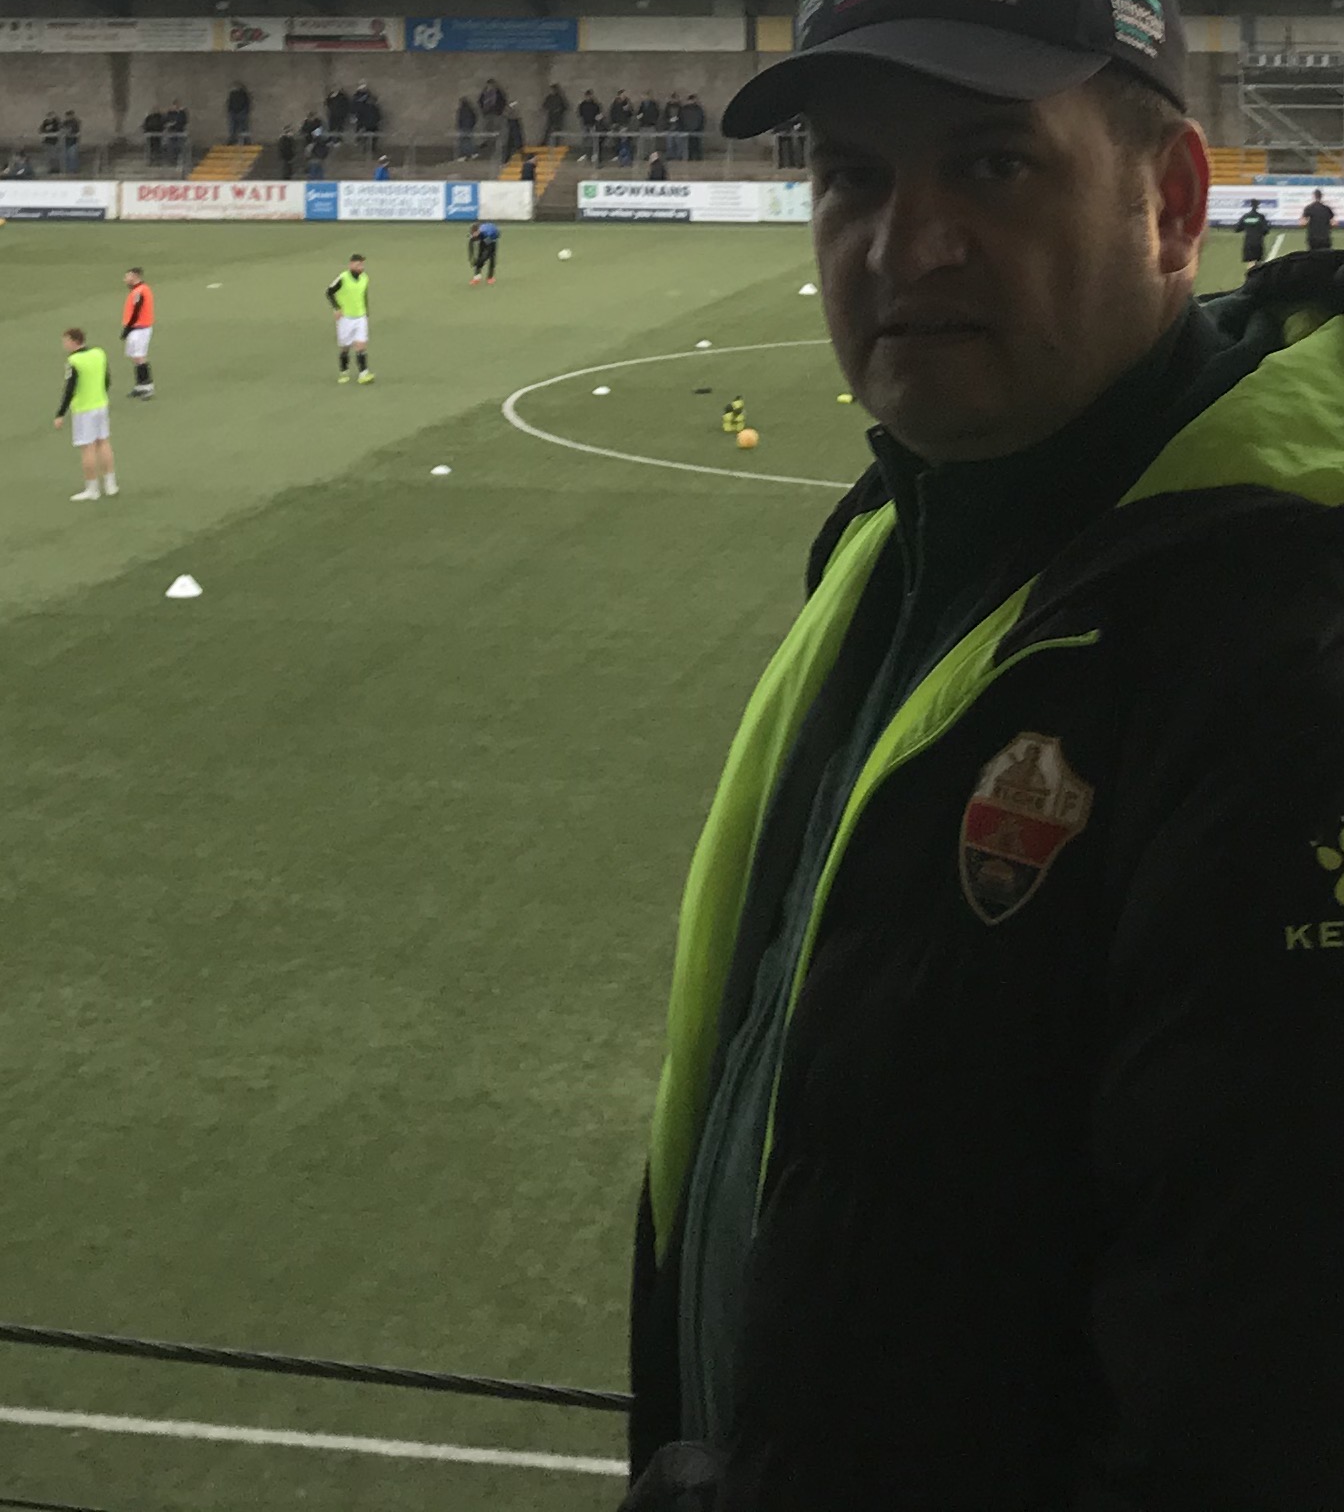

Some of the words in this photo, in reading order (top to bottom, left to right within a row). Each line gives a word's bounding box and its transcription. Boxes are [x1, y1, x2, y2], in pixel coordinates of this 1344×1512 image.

[137, 184, 221, 201] ROBERT
[231, 184, 288, 201] WATT
[604, 184, 691, 198] BOWMANS
